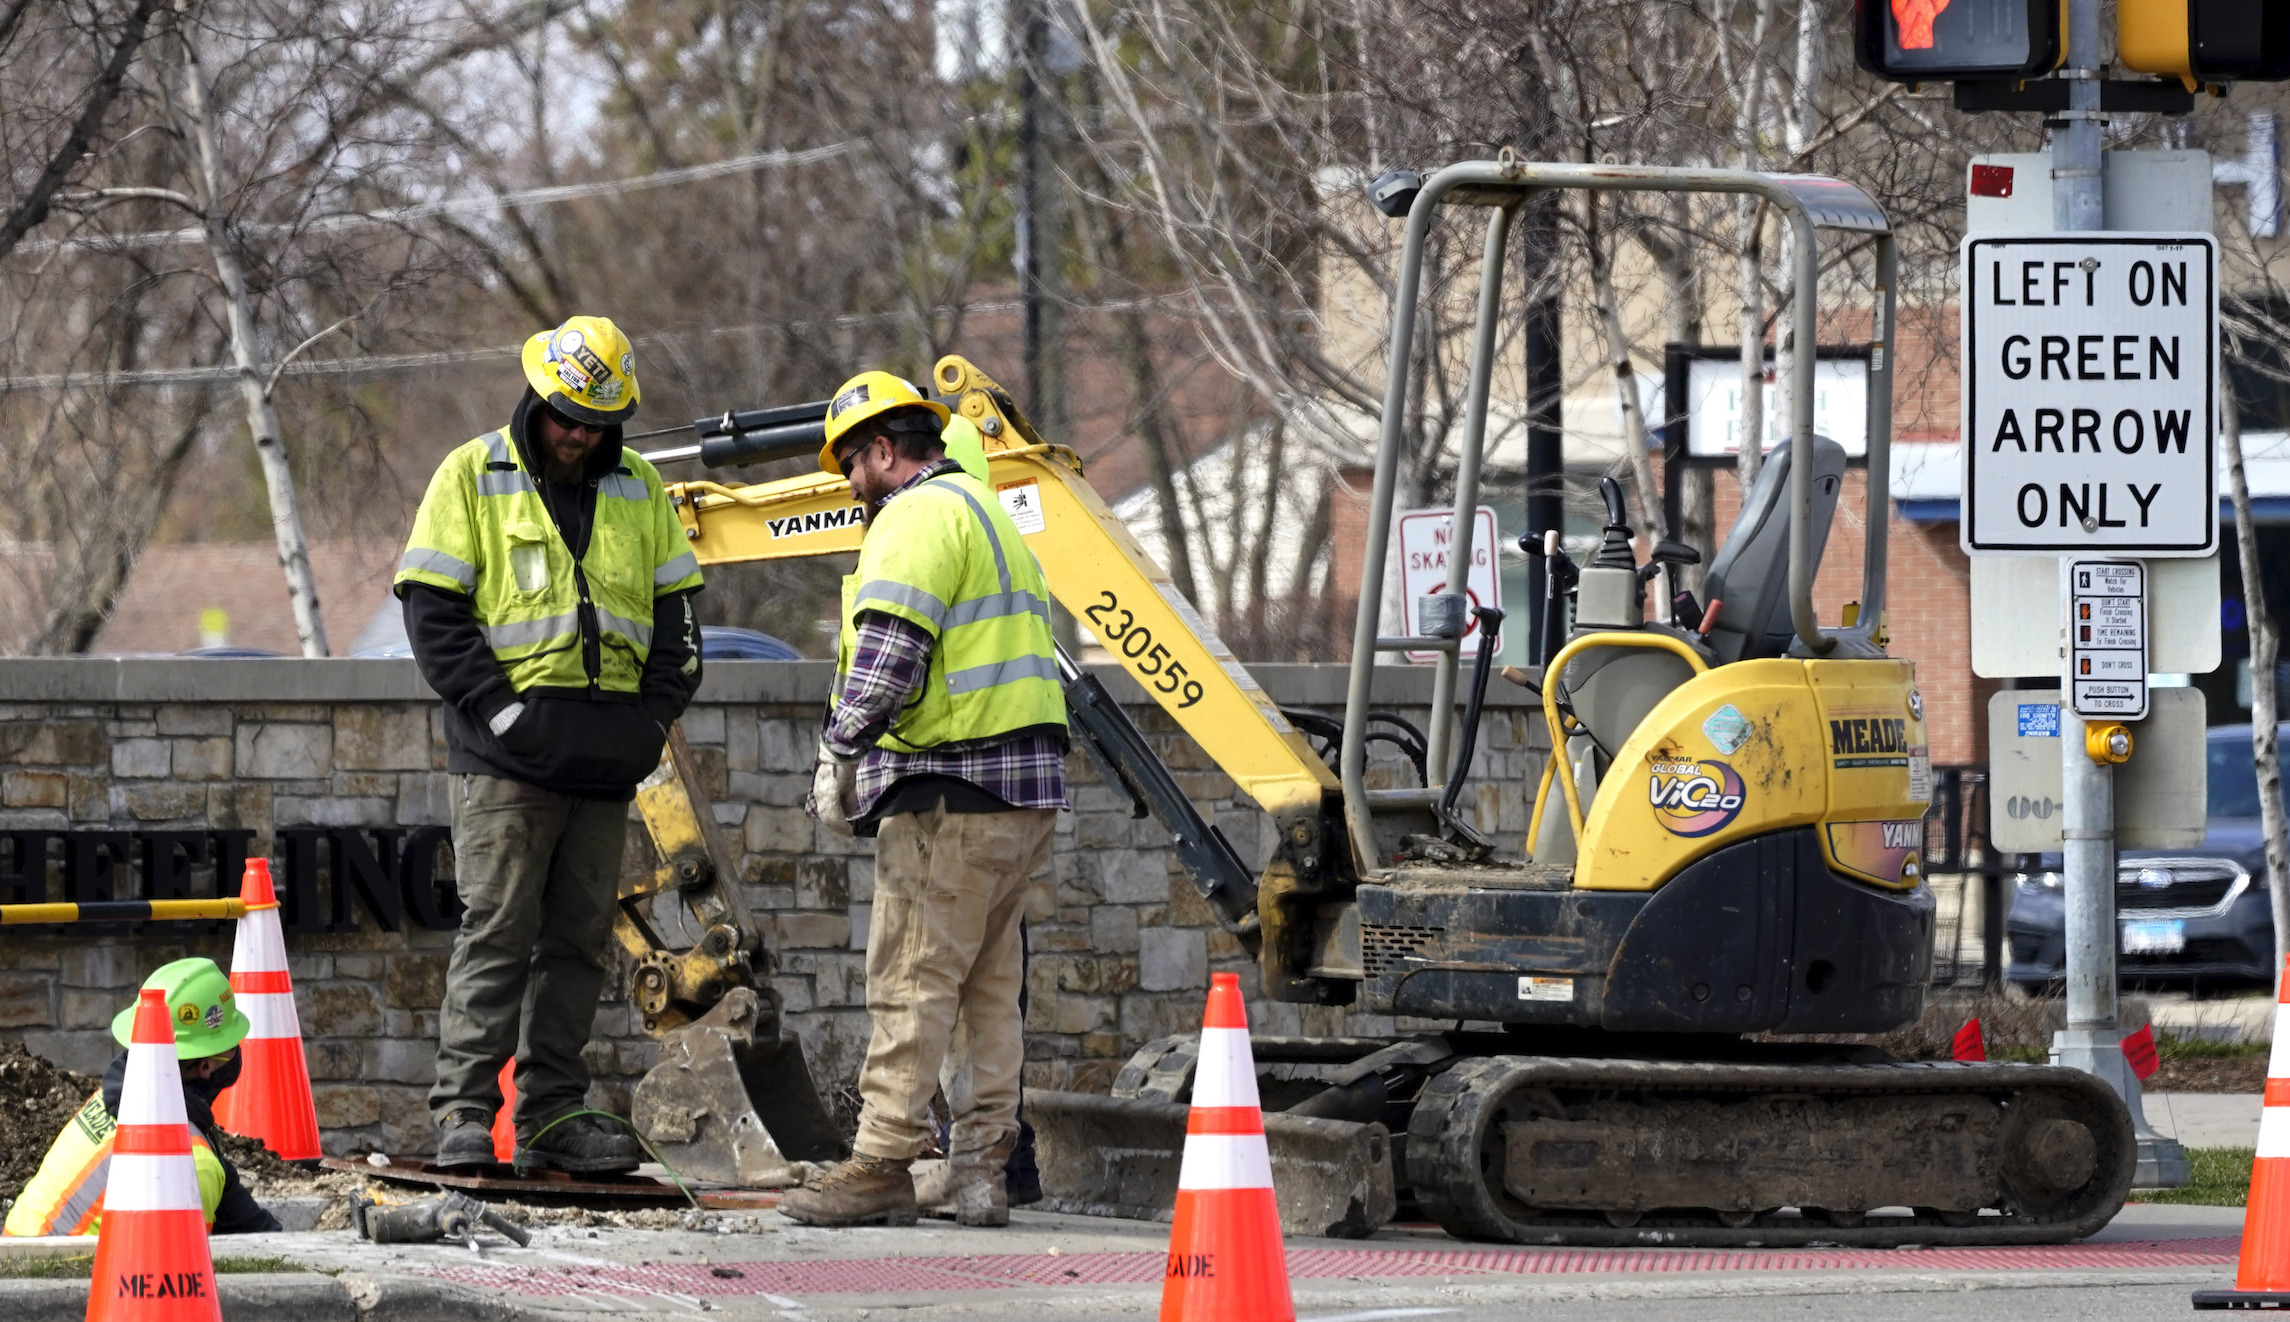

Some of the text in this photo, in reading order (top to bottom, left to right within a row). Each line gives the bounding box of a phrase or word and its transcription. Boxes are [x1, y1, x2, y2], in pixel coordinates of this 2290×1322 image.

[1993, 260, 2187, 307] LEFT ON
[577, 346, 611, 383] YETI
[2001, 334, 2180, 380] GREEN
[1992, 408, 2192, 454] ARROW
[2017, 482, 2162, 528] ONLY
[768, 506, 865, 537] YANMA
[1411, 548, 1487, 571] SKAG
[2112, 568, 2135, 576] CROSSING
[2101, 598, 2131, 606] DON'T START
[1084, 590, 1204, 709] 230559
[2101, 661, 2133, 669] DON'T CROSS
[2094, 700, 2124, 708] TO CROSS
[1830, 718, 1908, 755] MEADE
[1651, 763, 1702, 776] GLOBAL
[1882, 823, 1920, 848] YANM
[1166, 1254, 1215, 1277] EADE
[119, 1272, 206, 1298] MEADE
